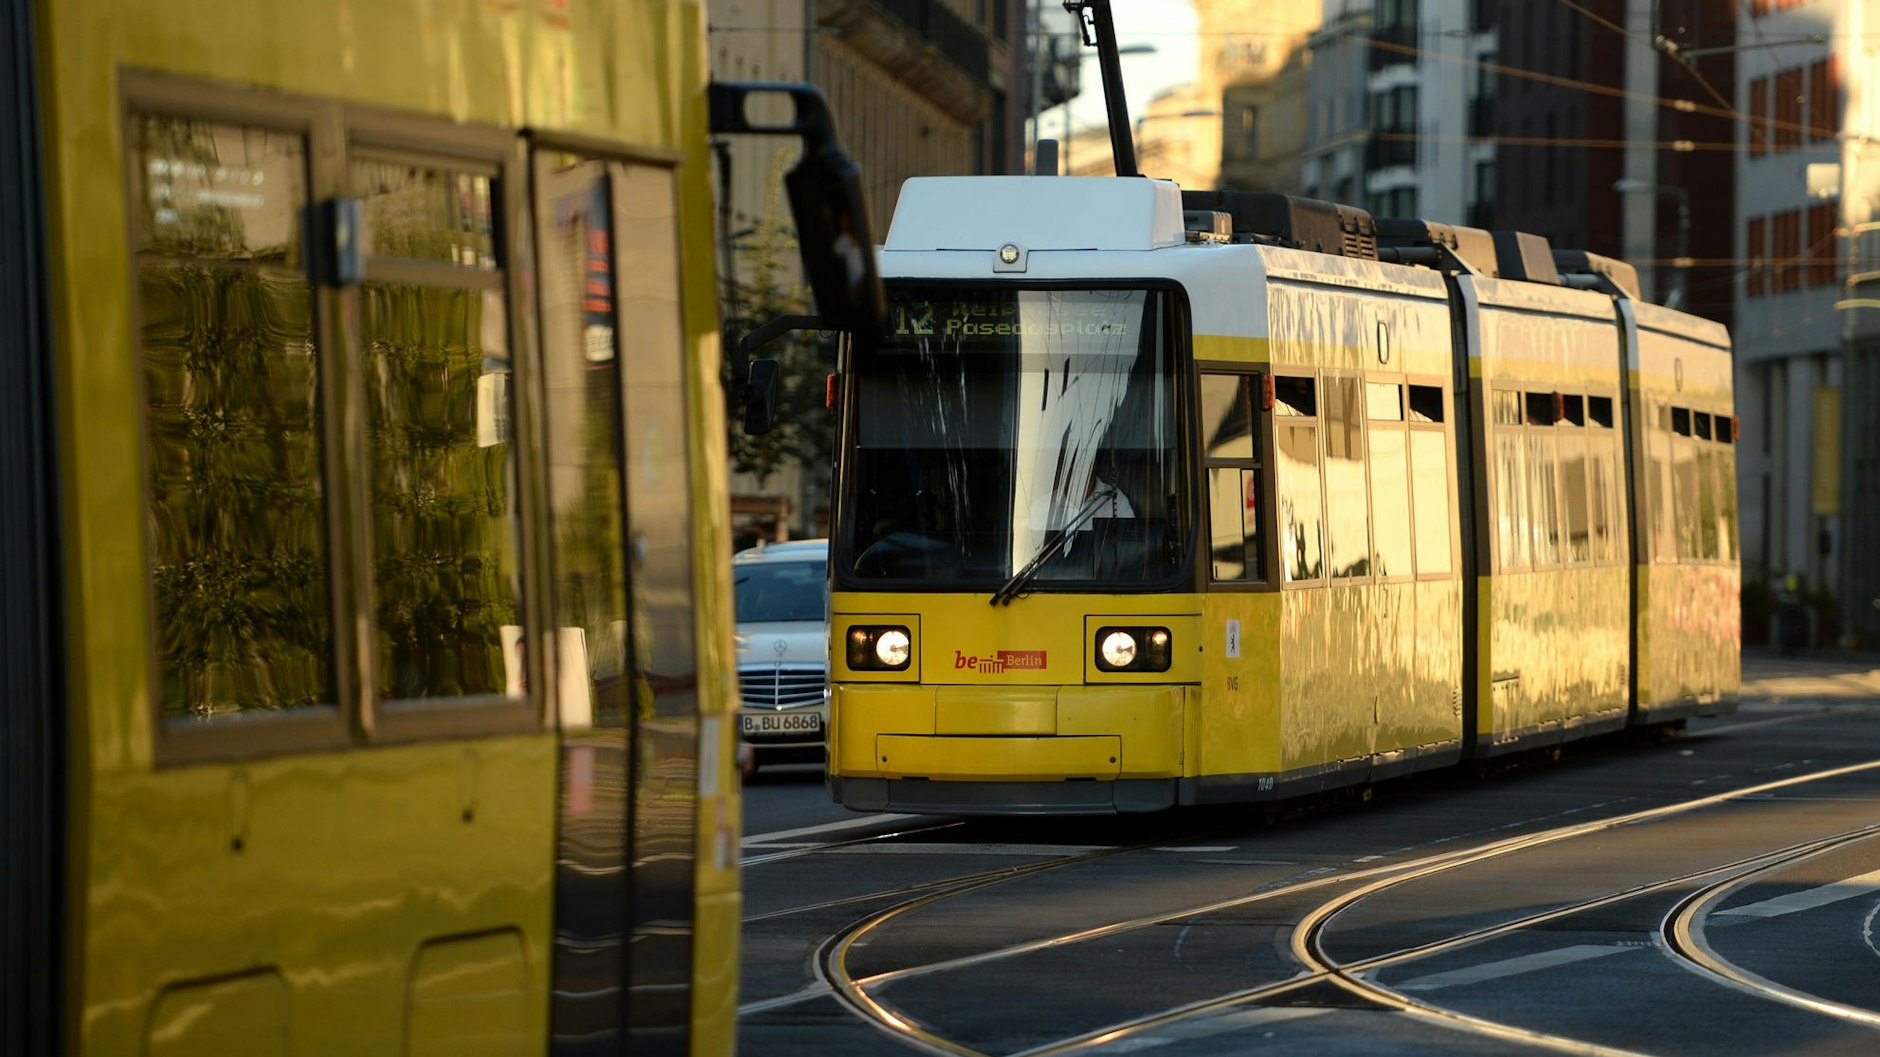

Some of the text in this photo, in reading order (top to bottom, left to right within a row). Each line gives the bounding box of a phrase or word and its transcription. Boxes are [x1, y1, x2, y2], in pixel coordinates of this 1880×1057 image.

[895, 302, 934, 335] 12
[955, 650, 1042, 669] be Berlin
[1227, 676, 1238, 691] BVG
[744, 715, 818, 730] B BU 6868
